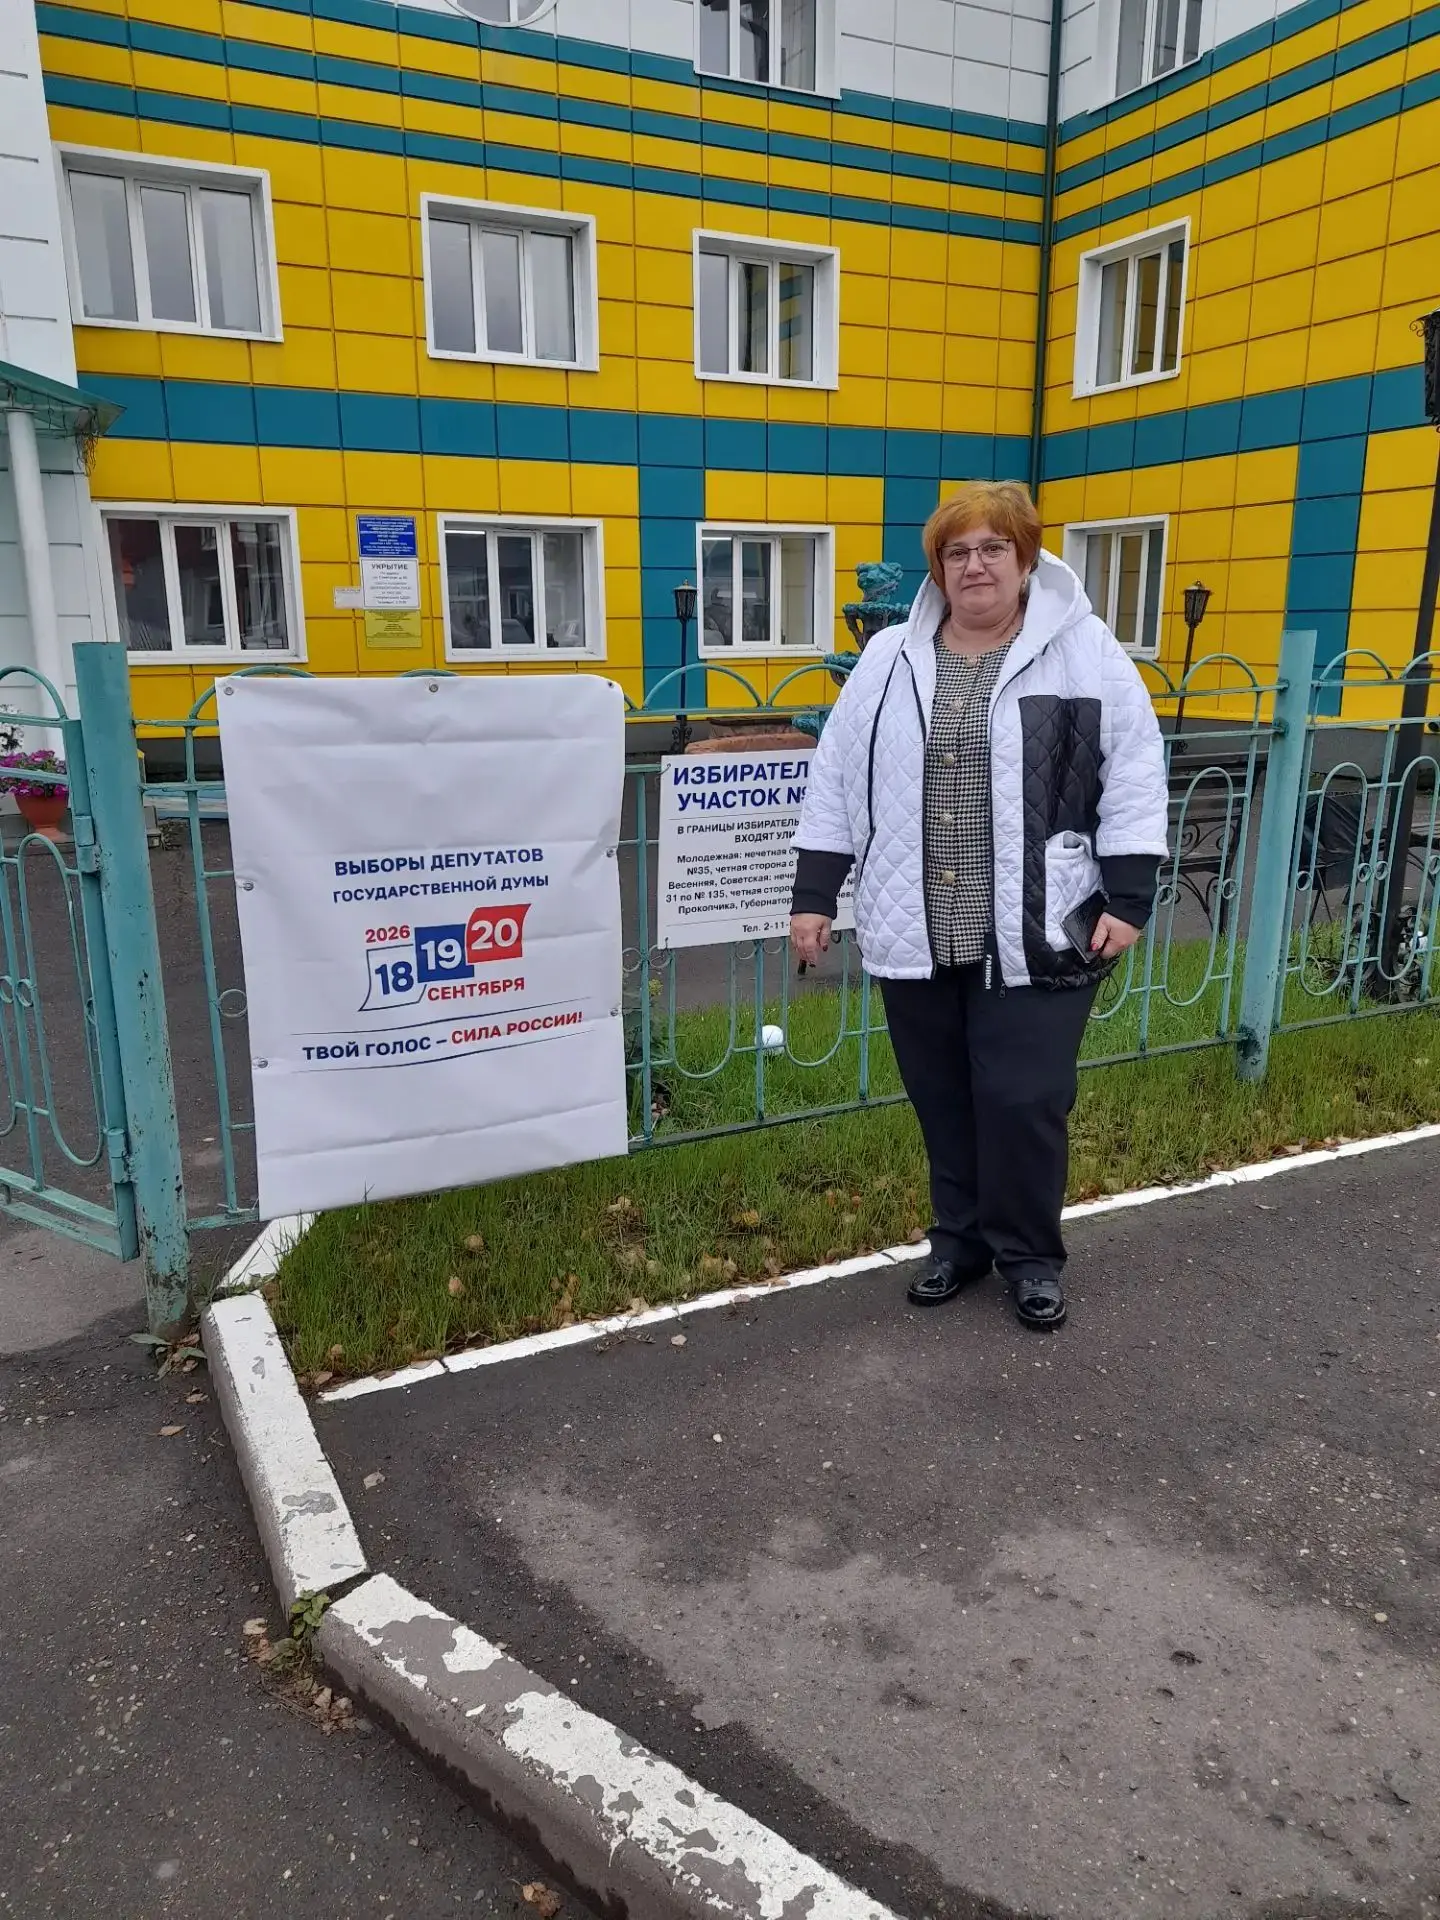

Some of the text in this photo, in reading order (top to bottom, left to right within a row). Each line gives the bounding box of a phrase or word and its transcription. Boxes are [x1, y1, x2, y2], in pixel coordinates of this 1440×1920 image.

[673, 761, 809, 786] ИЗБИРАТЕЛ
[677, 787, 781, 811] УЧАСТОК
[677, 825, 684, 834] В
[686, 822, 735, 833] ГРАНИЦЫ
[734, 832, 774, 844] ВХОДЯТ
[334, 848, 544, 877] ВЫБОРЫ ДЕПУТАТОВ
[677, 853, 742, 864] Молодежная:
[744, 849, 787, 858] нечетная
[715, 864, 748, 873] четная
[749, 861, 787, 871] сторона
[333, 875, 549, 903] ГОСУДАРСТВЕННОЙ ДУМЫ
[668, 880, 718, 890] Весенняя,
[720, 874, 772, 885] Советская:
[665, 894, 677, 903] 31
[680, 894, 692, 902] по
[694, 891, 705, 900] №
[708, 889, 728, 899] 135,
[730, 888, 762, 897] четная
[678, 902, 738, 915] Прокопчика,
[365, 925, 411, 944] 2026
[742, 921, 791, 933] Тел. 2-11-
[375, 918, 519, 996] 18 19 20
[427, 977, 525, 1002] СЕНТЯБРЯ
[302, 1042, 359, 1061] ТВОЙ
[365, 1037, 431, 1058] ГОЛОС
[451, 1025, 501, 1045] СИЛА
[506, 1011, 583, 1036] РОССИИ!
